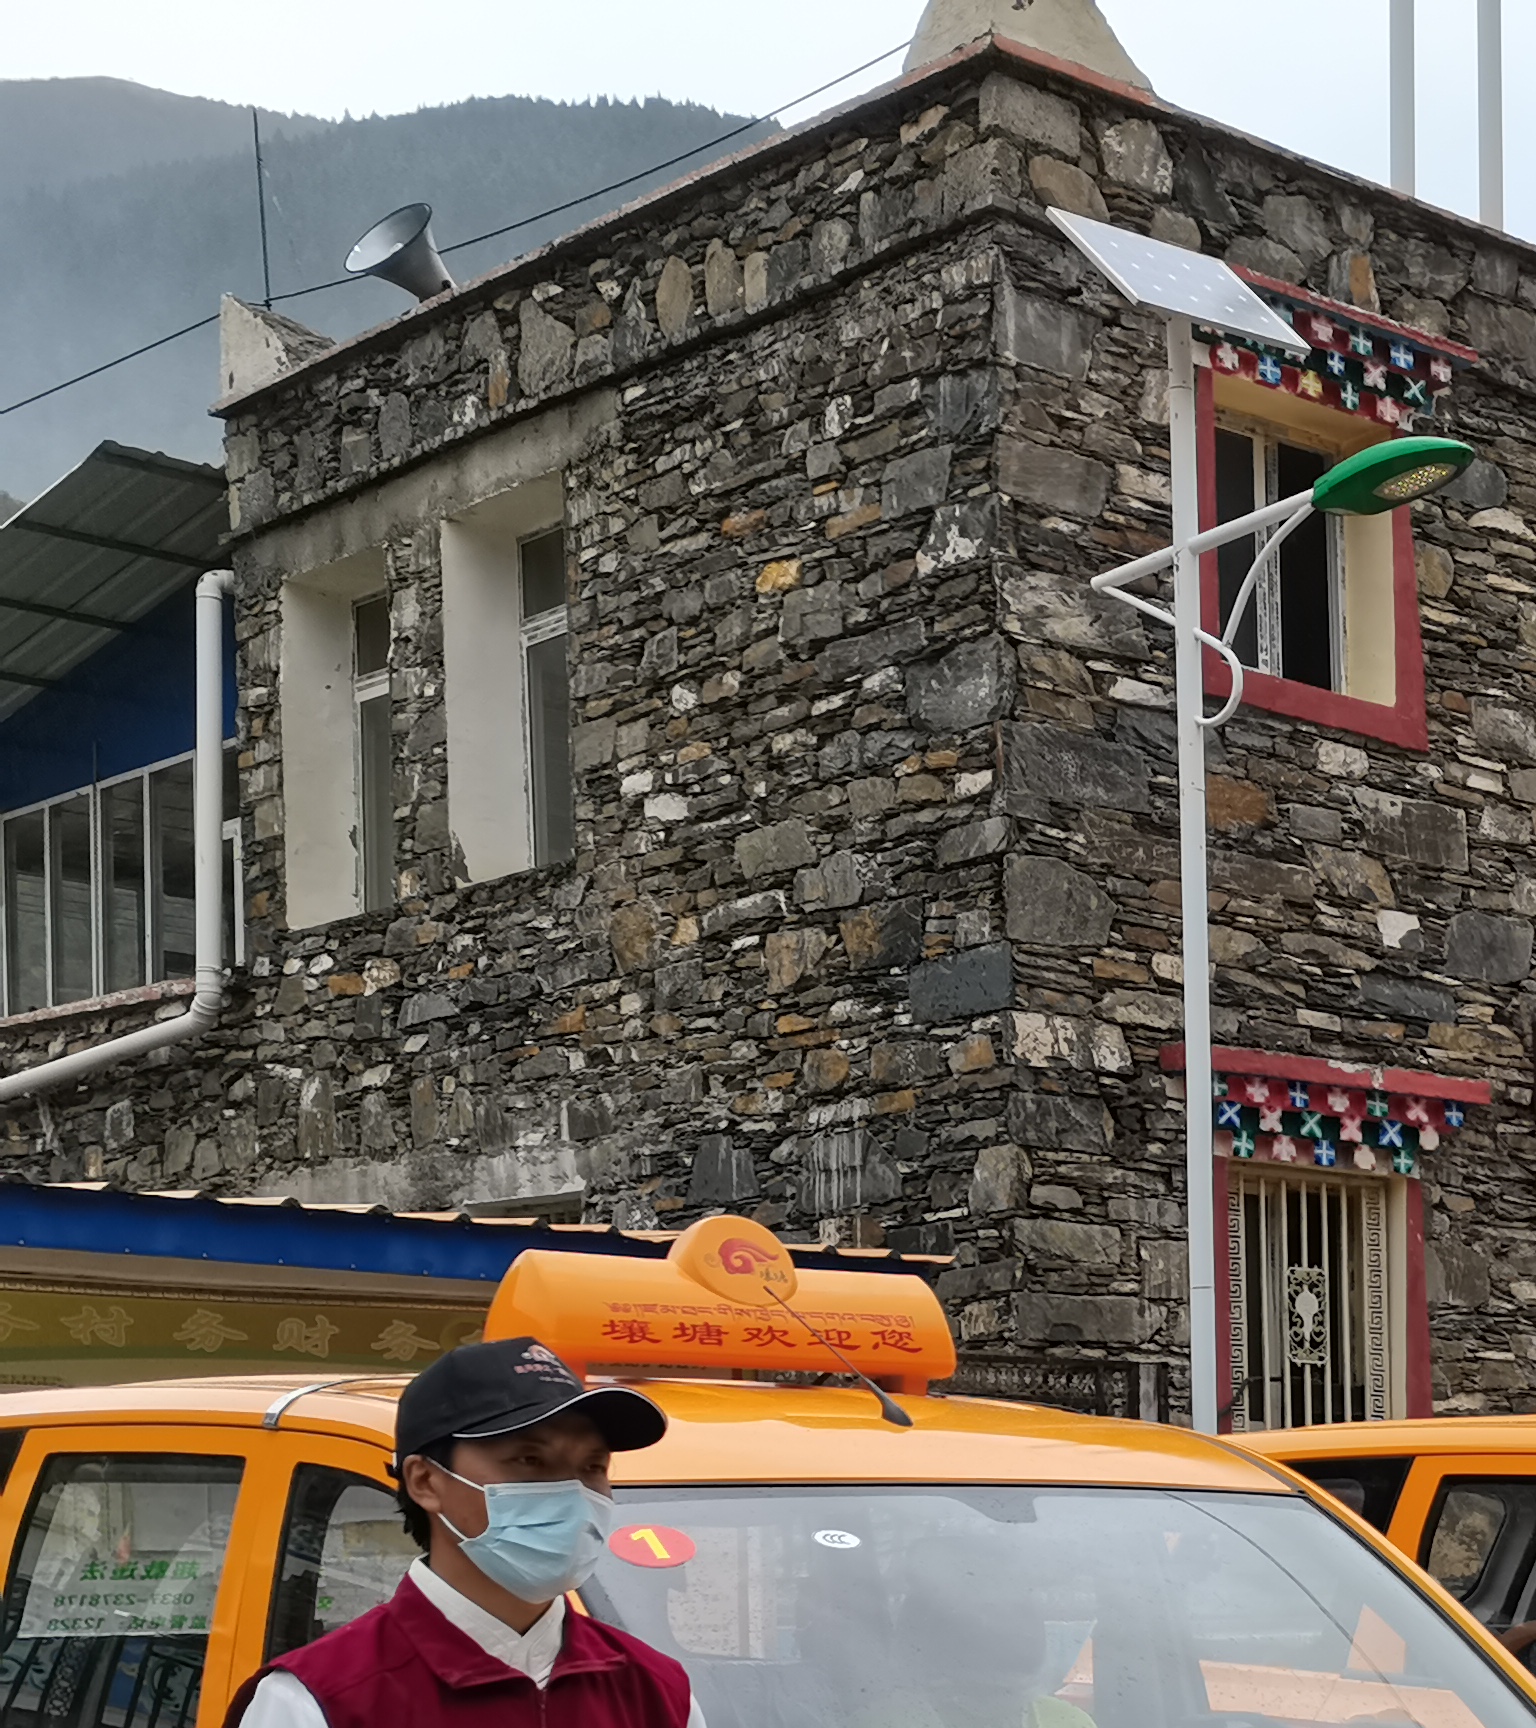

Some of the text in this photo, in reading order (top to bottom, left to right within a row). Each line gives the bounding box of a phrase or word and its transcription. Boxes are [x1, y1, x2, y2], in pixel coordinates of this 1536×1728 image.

[601, 1317, 923, 1354] 壤塘欢迎您
[630, 1528, 671, 1559] 1
